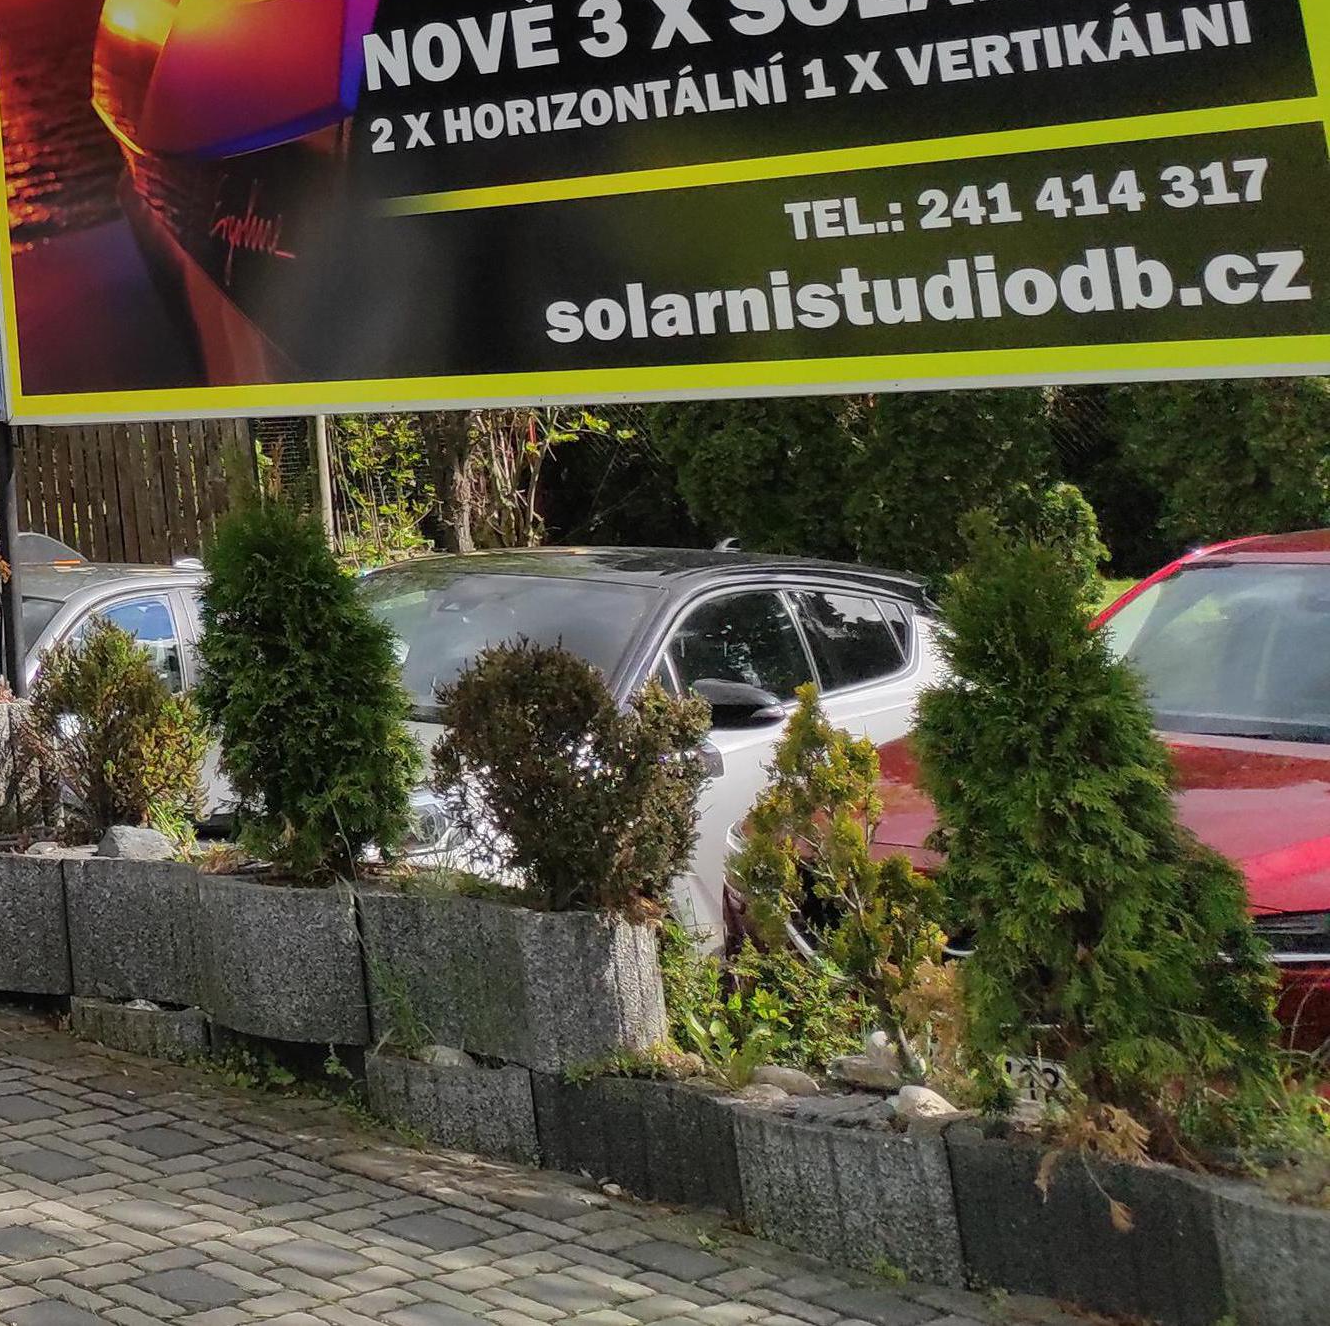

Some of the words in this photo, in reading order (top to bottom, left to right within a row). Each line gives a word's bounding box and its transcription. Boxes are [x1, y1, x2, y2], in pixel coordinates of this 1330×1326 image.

[369, 114, 397, 155] 2
[401, 112, 436, 150] X
[444, 51, 789, 145] HORIZONTÁLNÍ
[802, 57, 835, 101] 1
[848, 51, 887, 95] X
[783, 193, 903, 242] TEL.:
[916, 182, 1023, 228] 241
[1033, 174, 1143, 220] 414
[1158, 159, 1270, 211] 317
[544, 246, 1313, 345] solarnistudiodb.cz
